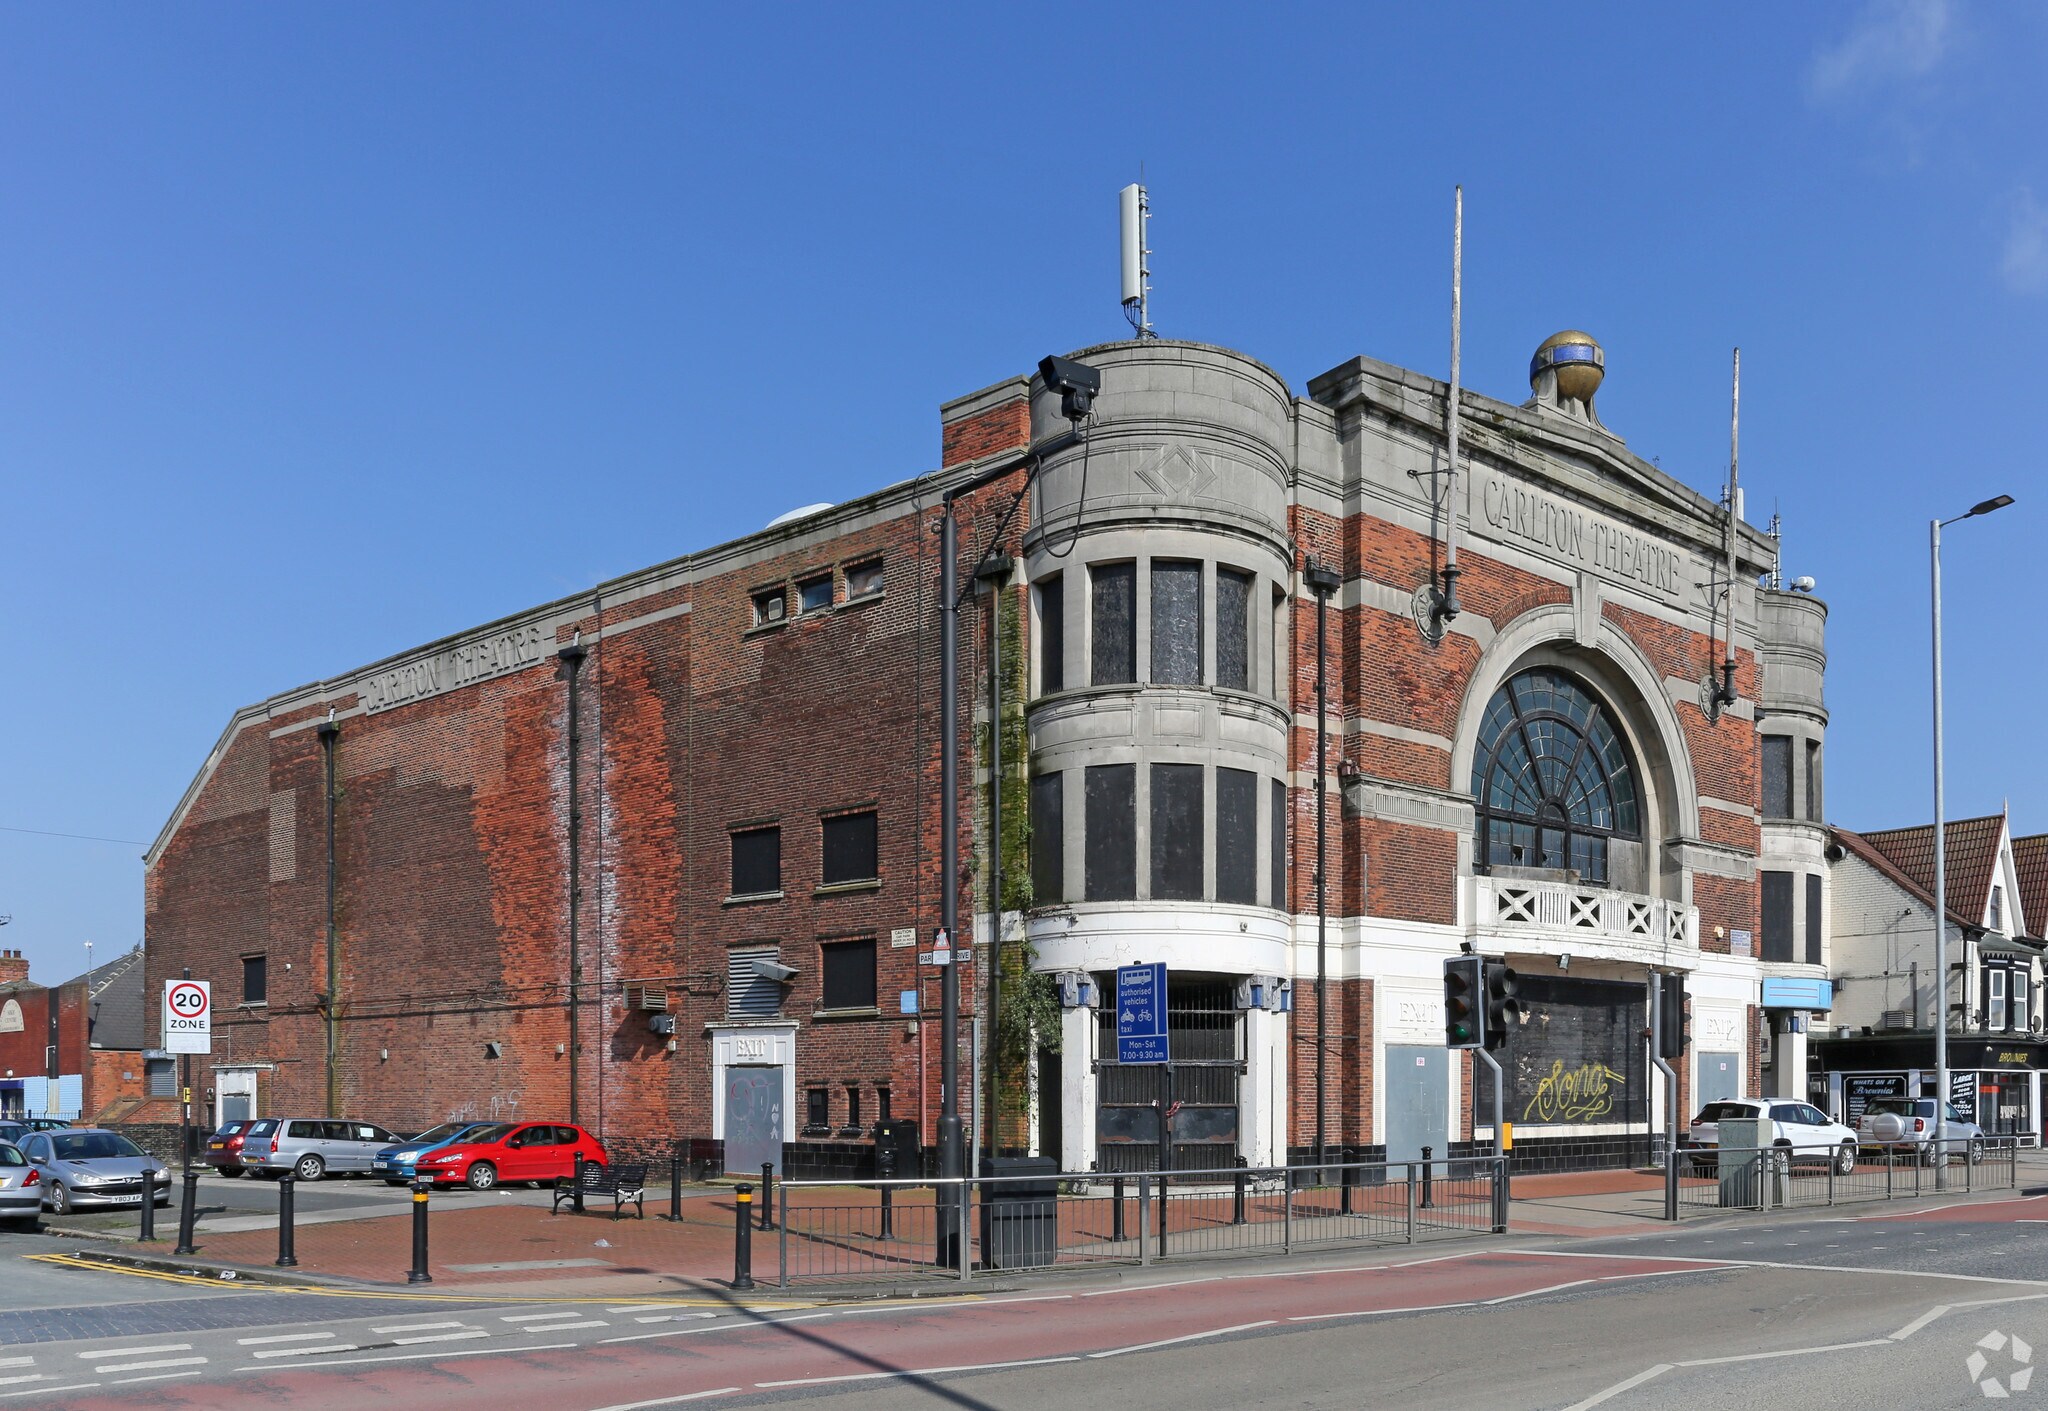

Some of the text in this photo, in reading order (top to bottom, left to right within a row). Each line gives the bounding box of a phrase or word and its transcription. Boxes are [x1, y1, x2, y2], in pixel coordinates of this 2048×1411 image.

[1483, 477, 1681, 597] CARLTON THEATRE
[366, 627, 540, 710] CARLTON THEATRE
[1121, 987, 1151, 997] authorised
[175, 993, 202, 1008] 20
[1124, 997, 1147, 1005] vehicles
[1399, 1001, 1438, 1023] EXIT
[170, 1019, 206, 1029] ZONE
[736, 1038, 767, 1057] EXIT
[1953, 1073, 1973, 1084] LARGE
